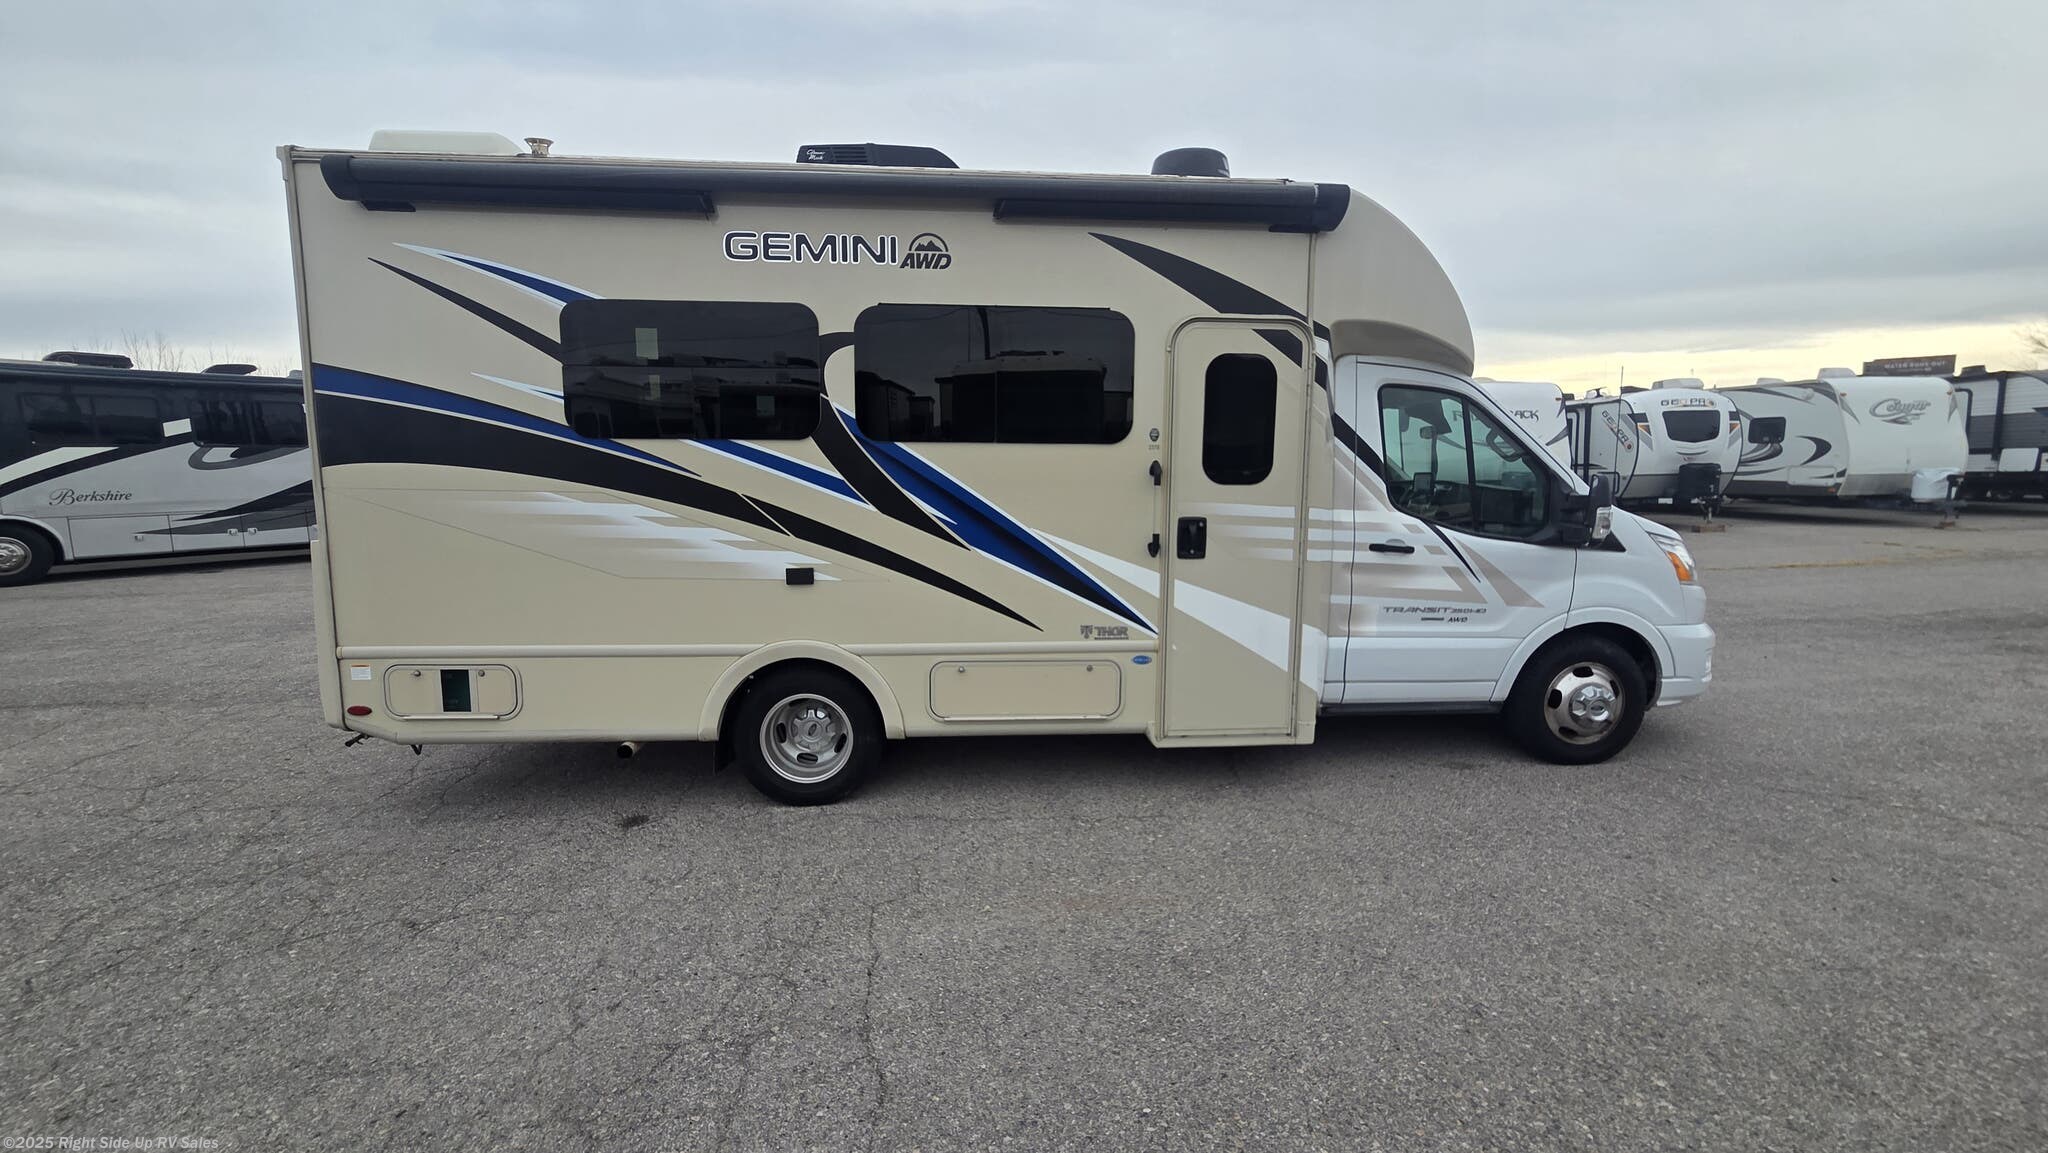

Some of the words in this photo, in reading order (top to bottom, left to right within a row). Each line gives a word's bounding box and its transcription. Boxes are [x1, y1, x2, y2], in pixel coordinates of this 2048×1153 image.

[722, 230, 898, 265] GEMINI
[899, 252, 952, 270] AWD
[1509, 410, 1539, 422] ACK
[49, 487, 133, 506] Berkshire
[1383, 606, 1452, 614] TRANSIT
[1094, 626, 1129, 636] THOR
